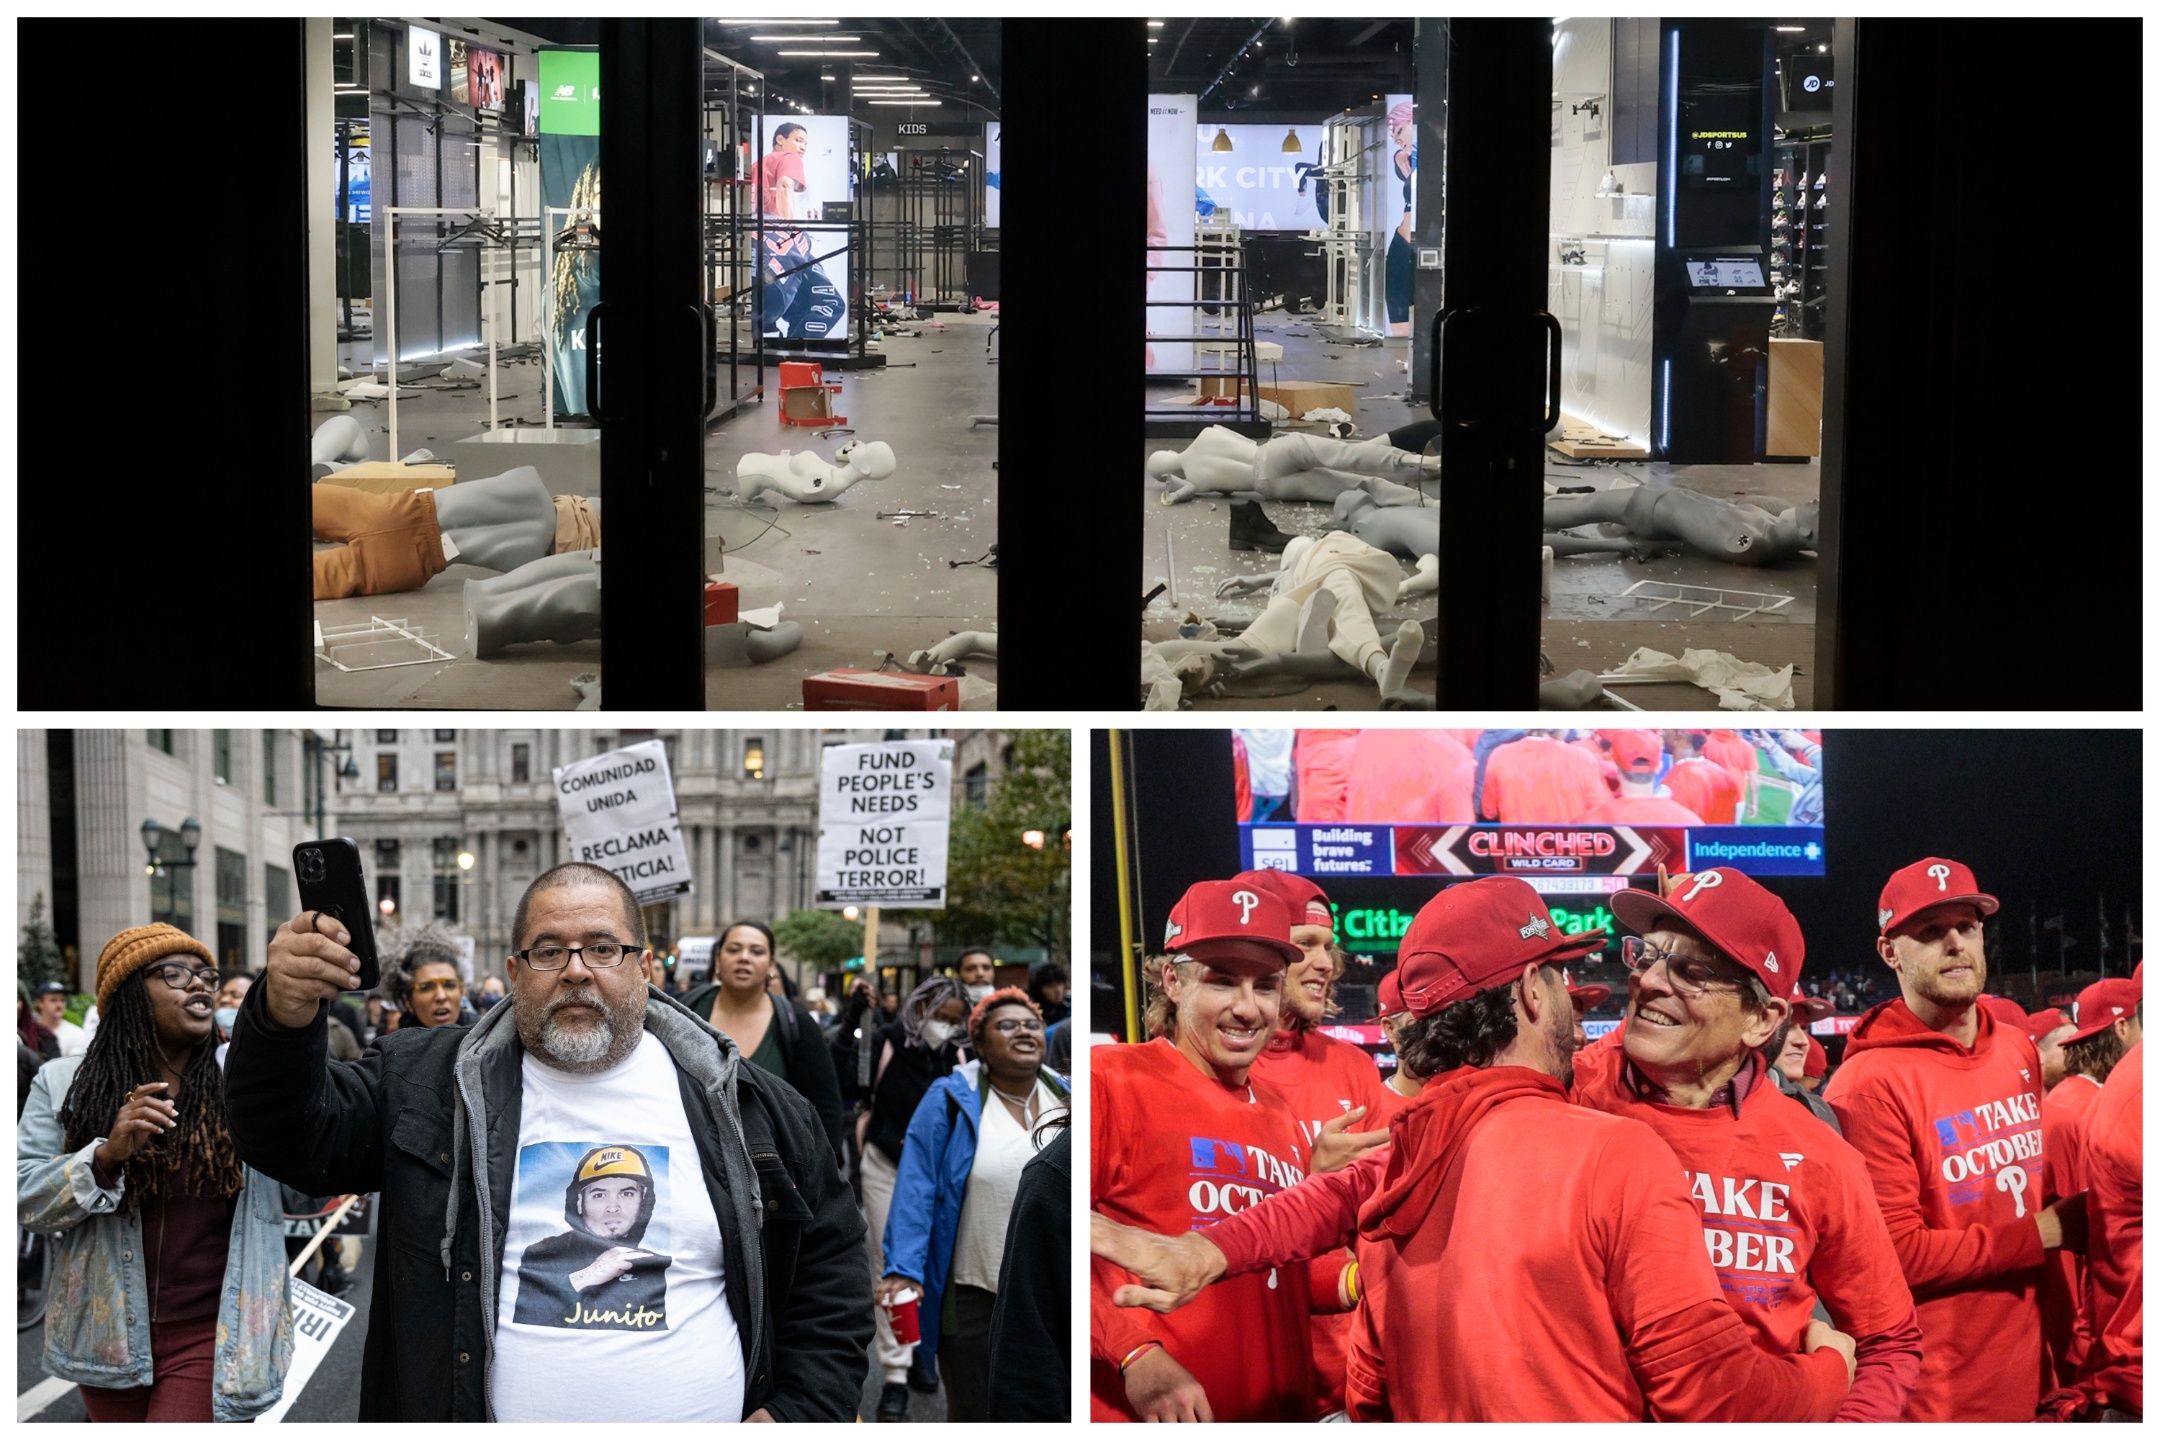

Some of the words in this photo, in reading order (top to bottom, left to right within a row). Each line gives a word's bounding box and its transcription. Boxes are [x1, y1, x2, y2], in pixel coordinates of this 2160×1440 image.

[898, 123, 927, 135] KIDS
[1236, 167, 1307, 189] CITY
[859, 752, 915, 770] FUND
[561, 758, 656, 794] COMUNIDAD
[838, 772, 935, 793] PEOPLE'S
[587, 789, 638, 813] UNIDA
[852, 795, 918, 813] NEEDS
[860, 827, 905, 844] NOT
[1312, 829, 1373, 846] Building
[1468, 831, 1616, 857] CLINCHED
[582, 828, 670, 862] RECLAMA
[1312, 843, 1354, 857] brave
[1695, 841, 1801, 860] Independence
[845, 848, 918, 866] POLICE
[1511, 859, 1541, 868] WILD
[1542, 859, 1575, 868] CARD
[836, 869, 924, 887] TERROR!
[1974, 1092, 2041, 1133] TAKE
[601, 1152, 622, 1162] NIKE
[1684, 1170, 1790, 1223] AKE
[564, 1302, 664, 1328] Junito
